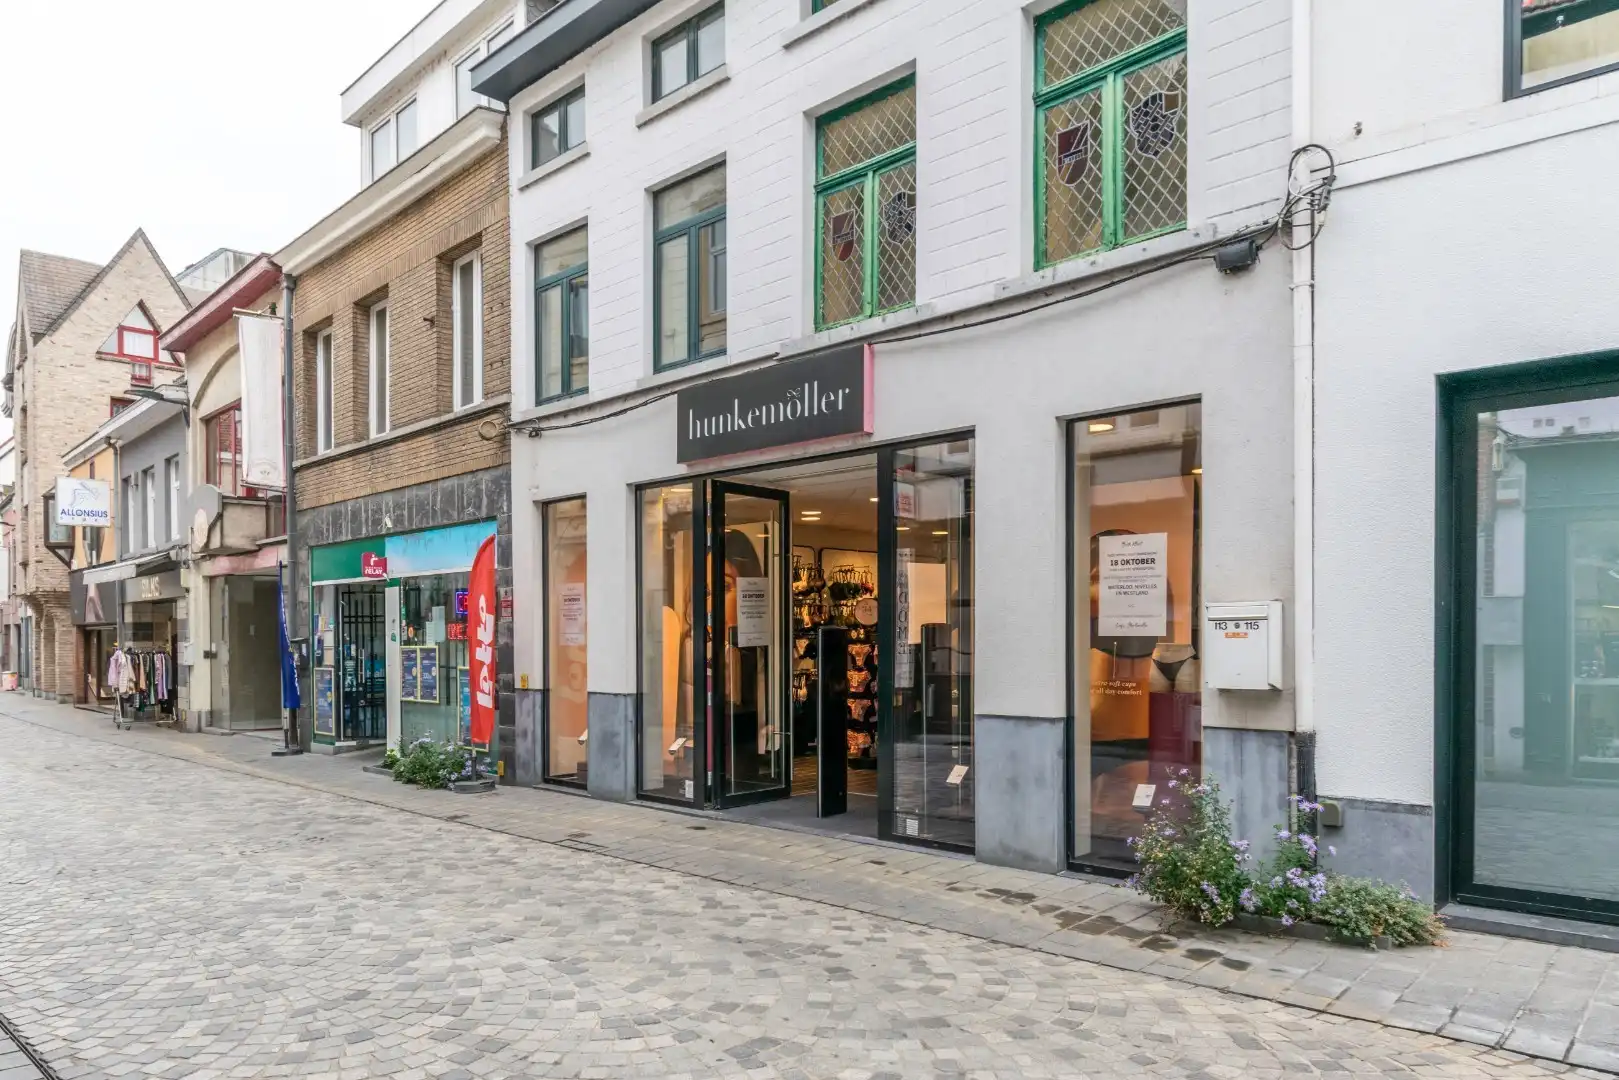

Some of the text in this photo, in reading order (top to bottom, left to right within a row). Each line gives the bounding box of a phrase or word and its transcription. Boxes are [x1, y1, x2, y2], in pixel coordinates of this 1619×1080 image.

[688, 380, 850, 440] hunkemöller
[60, 508, 108, 518] ALLONSIUS
[1120, 557, 1156, 566] OKTOBER
[1214, 621, 1260, 631] 113 115
